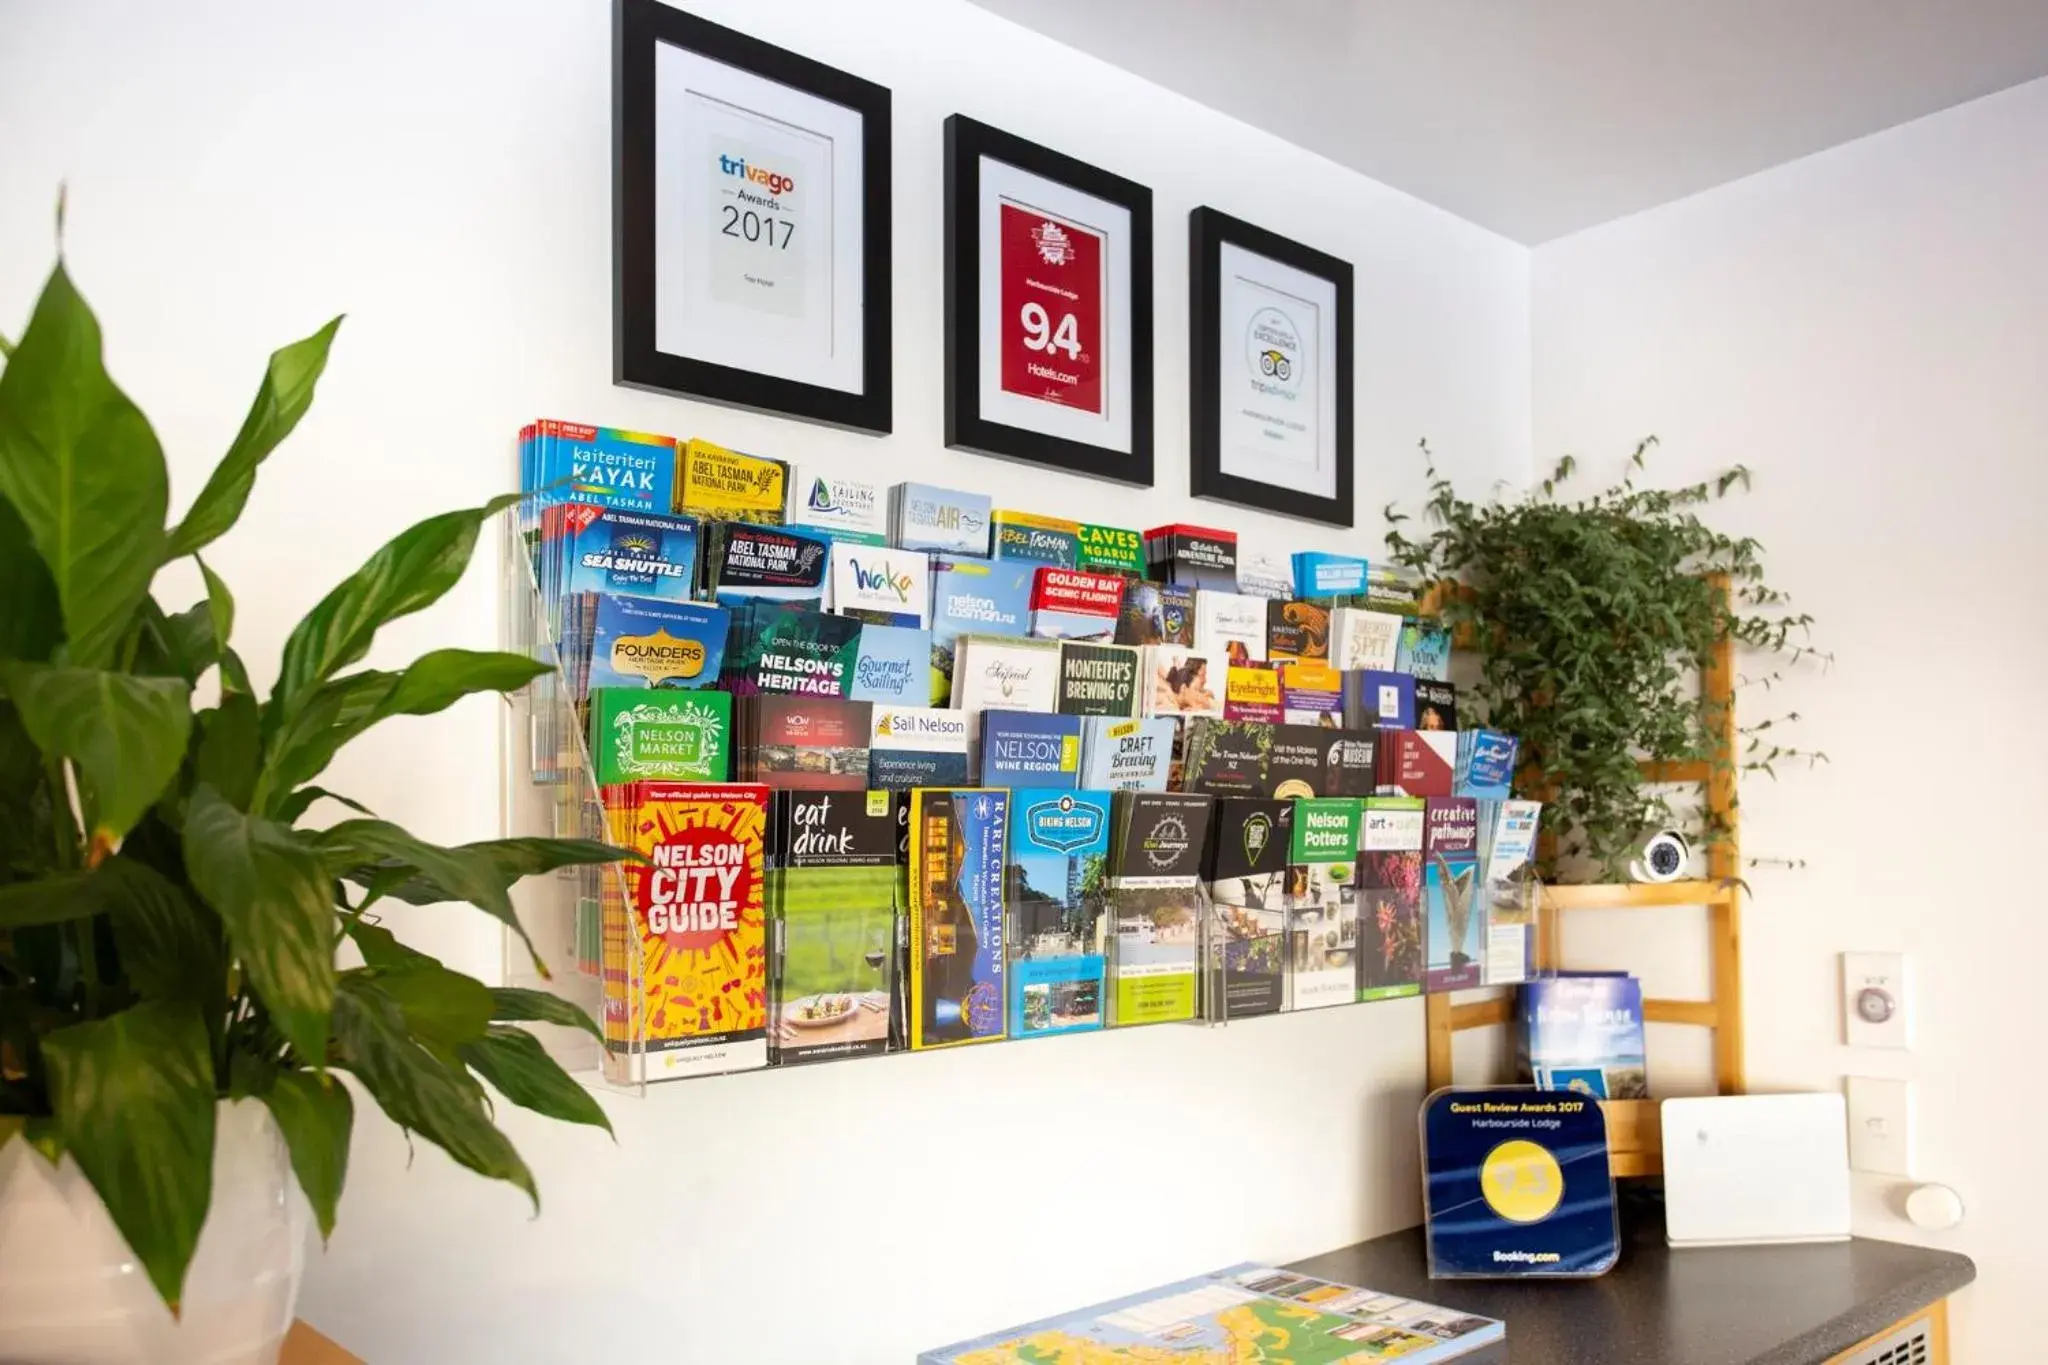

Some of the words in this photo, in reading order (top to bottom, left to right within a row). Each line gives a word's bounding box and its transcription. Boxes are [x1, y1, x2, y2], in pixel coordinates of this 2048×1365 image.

[719, 154, 794, 195] trivago
[738, 189, 780, 210] Awards
[722, 205, 794, 250] 2017
[1021, 302, 1082, 360] 9.4
[1027, 363, 1077, 385] Hotels.com
[574, 446, 656, 470] kaiteriteri
[572, 463, 655, 491] KAYAK
[692, 460, 714, 476] ABEL
[718, 465, 753, 482] TASMAN
[692, 474, 725, 490] NATIONAL
[727, 480, 746, 492] PARK
[569, 492, 599, 504] ABEL
[607, 496, 652, 509] TASMAN
[832, 487, 875, 503] SAILING
[910, 500, 937, 514] NELSON
[601, 513, 617, 523] ABEL
[619, 515, 644, 525] TASMAN
[645, 519, 675, 530] NATIONAL
[676, 523, 691, 532] PARK
[937, 506, 960, 530] AIR
[1000, 529, 1028, 545] ABEL
[1029, 531, 1070, 551] TASMAN
[1077, 526, 1139, 549] CAVES
[730, 541, 756, 556] ABEL
[757, 544, 797, 561] TASMAN
[1084, 545, 1136, 561] NGARUA
[1177, 550, 1216, 562] ADVENTURE
[1217, 555, 1235, 566] PARK
[581, 553, 612, 569] SEA
[615, 557, 684, 577] SHUTTLE
[727, 554, 766, 569] NATIONAL
[767, 560, 788, 572] PARK
[1090, 557, 1118, 565] TAKAKA
[1118, 560, 1132, 568] HILL
[850, 558, 915, 603] Waka
[1047, 573, 1096, 589] GOLDEN
[1097, 579, 1121, 592] BAY
[948, 593, 995, 610] nelson
[1045, 587, 1080, 599] SCENIC
[1081, 592, 1118, 603] FLIGHTS
[948, 605, 1016, 624] tasman.nz
[615, 644, 701, 660] FOUNDERS
[771, 637, 792, 647] OPEN
[793, 638, 806, 649] THE
[807, 641, 829, 652] DOOR
[760, 653, 844, 677] NELSON'S
[858, 655, 912, 679] Gourmet
[985, 660, 1032, 685] Seifried
[1065, 659, 1132, 681] MONTEITH'S
[758, 673, 840, 695] HERITAGE
[861, 673, 908, 695] Sailing
[1066, 682, 1115, 699] BREWING
[1230, 681, 1277, 697] Eyebright
[785, 715, 810, 725] WOW
[892, 715, 915, 731] Sail
[919, 717, 964, 733] Nelson
[640, 730, 695, 742] NELSON
[1113, 723, 1134, 736] NELSON
[640, 742, 694, 755] MARKET
[995, 740, 1061, 760] NELSON
[1120, 736, 1154, 753] CRAFT
[1273, 744, 1286, 753] Visit
[1286, 745, 1296, 754] the
[878, 758, 914, 770] Experience
[995, 761, 1021, 771] WINE
[1024, 762, 1059, 772] REGION
[1111, 754, 1157, 769] Brewing
[1273, 756, 1278, 764] of
[1290, 757, 1305, 766] One
[1305, 758, 1318, 767] Ring
[879, 773, 895, 783] and
[896, 774, 923, 785] cruising
[668, 791, 691, 799] official
[693, 792, 711, 800] guide
[744, 792, 757, 800] City
[794, 795, 832, 826] eat
[1430, 806, 1476, 822] creative
[992, 801, 1005, 853] RARE
[1039, 815, 1063, 827] BIKING
[1065, 816, 1092, 828] NELSON
[1307, 812, 1349, 828] Nelson
[1369, 818, 1385, 829] art
[793, 825, 854, 854] drink
[1158, 841, 1189, 850] Journeys
[1304, 831, 1348, 847] Potters
[1429, 825, 1476, 850] pathways
[653, 843, 745, 867] NELSON
[651, 866, 742, 904] CITY
[648, 901, 738, 934] GUIDE
[991, 861, 1005, 974] CREATIONS
[1451, 1103, 1482, 1113] Guest
[1483, 1103, 1519, 1113] Review
[1520, 1103, 1556, 1113] Awards
[1559, 1103, 1584, 1112] 2017
[1472, 1118, 1530, 1128] Harbourside
[1532, 1119, 1562, 1130] Lodge
[1493, 1251, 1560, 1263] Booking.com
